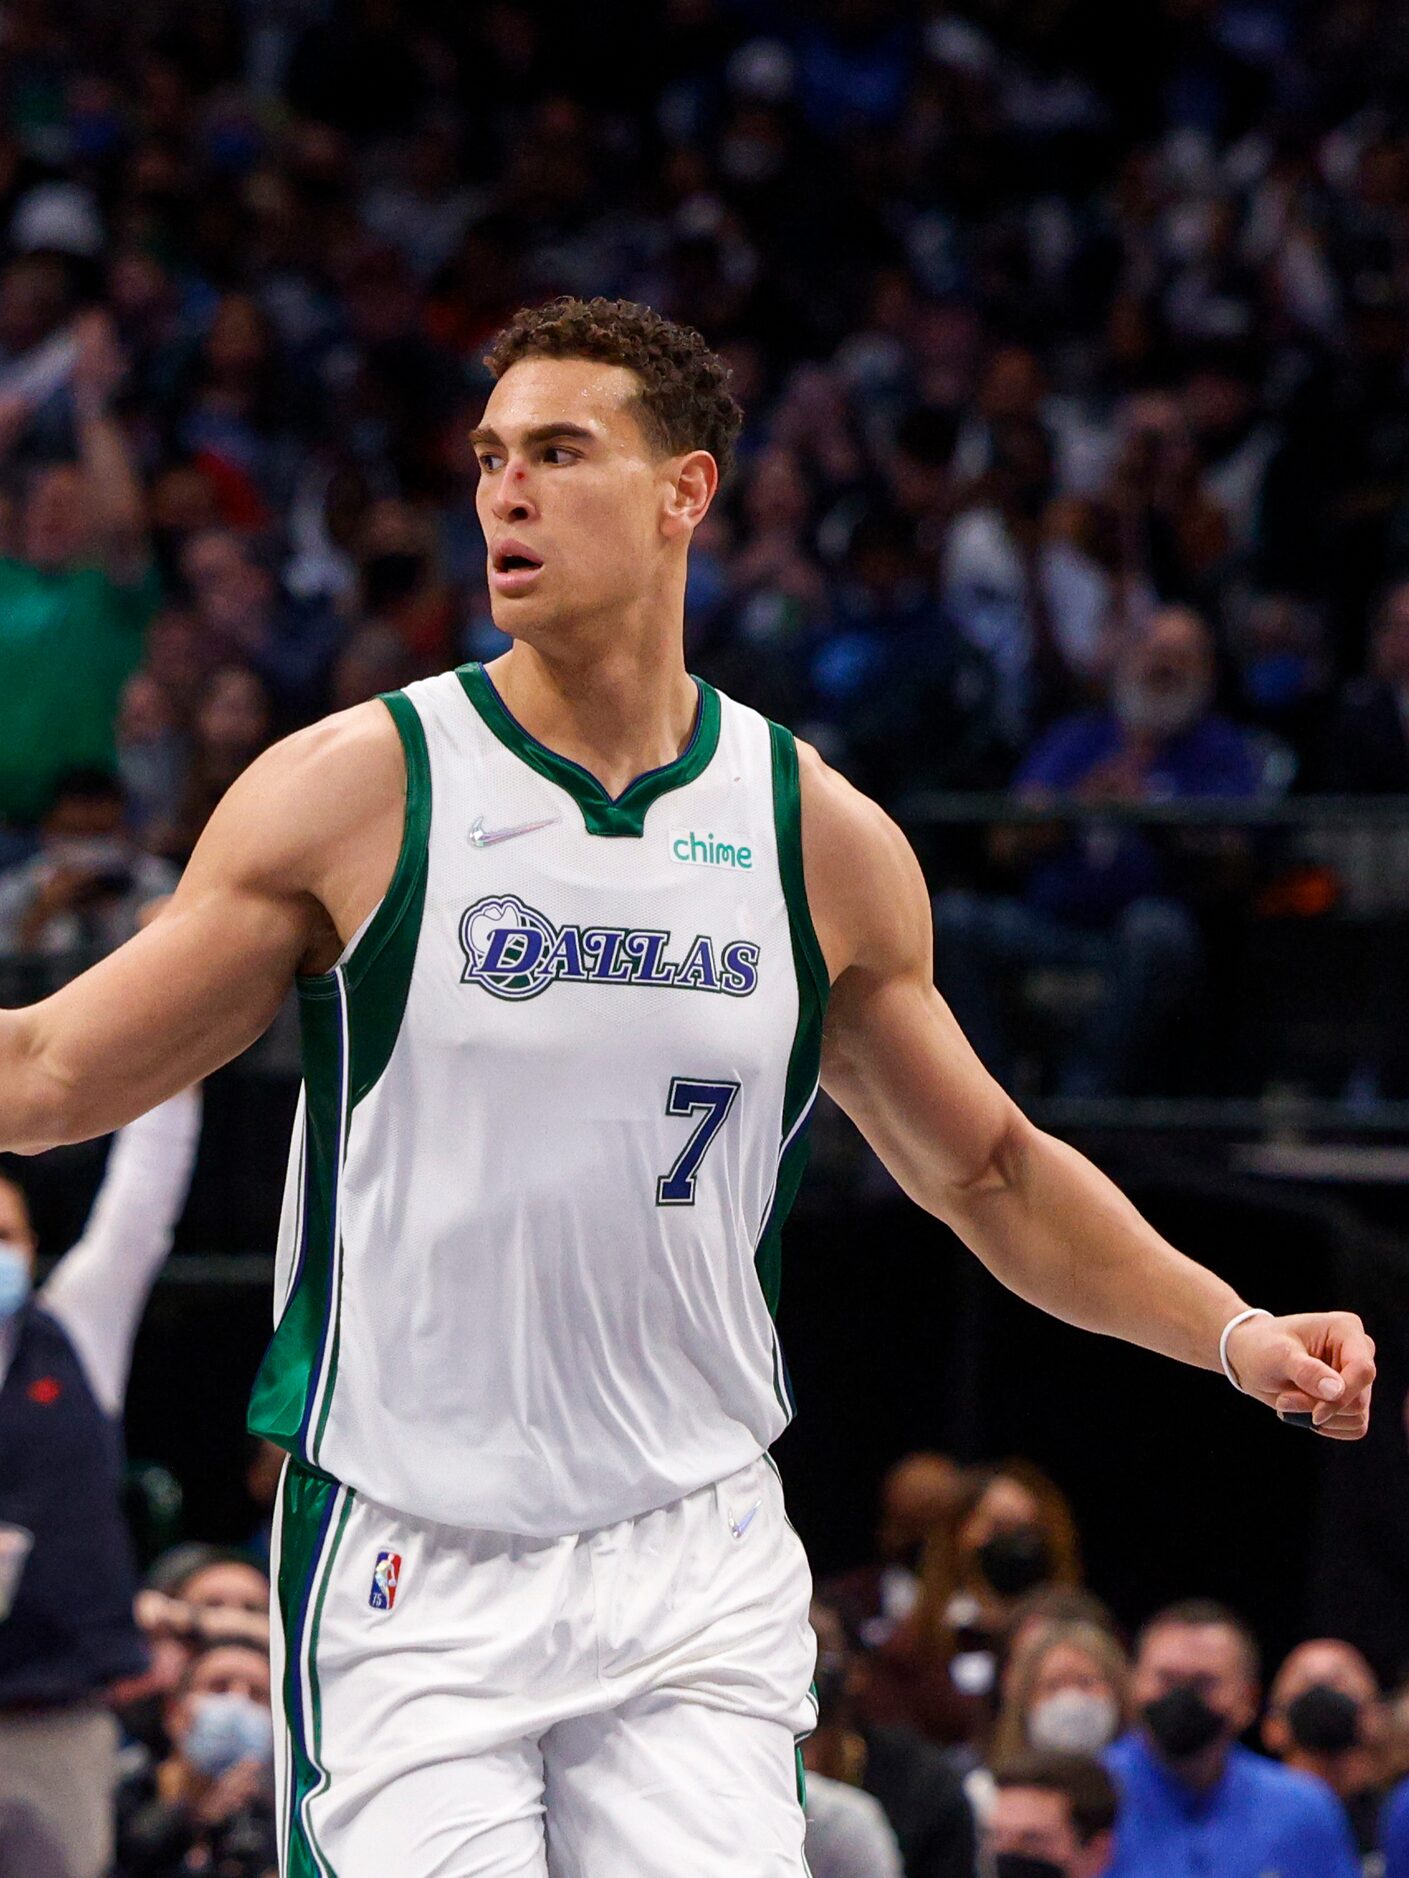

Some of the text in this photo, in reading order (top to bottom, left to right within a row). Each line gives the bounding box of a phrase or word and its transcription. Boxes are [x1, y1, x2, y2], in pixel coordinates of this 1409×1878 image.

[673, 831, 753, 869] chime
[466, 925, 761, 998] DALLAS
[655, 1076, 742, 1207] 7
